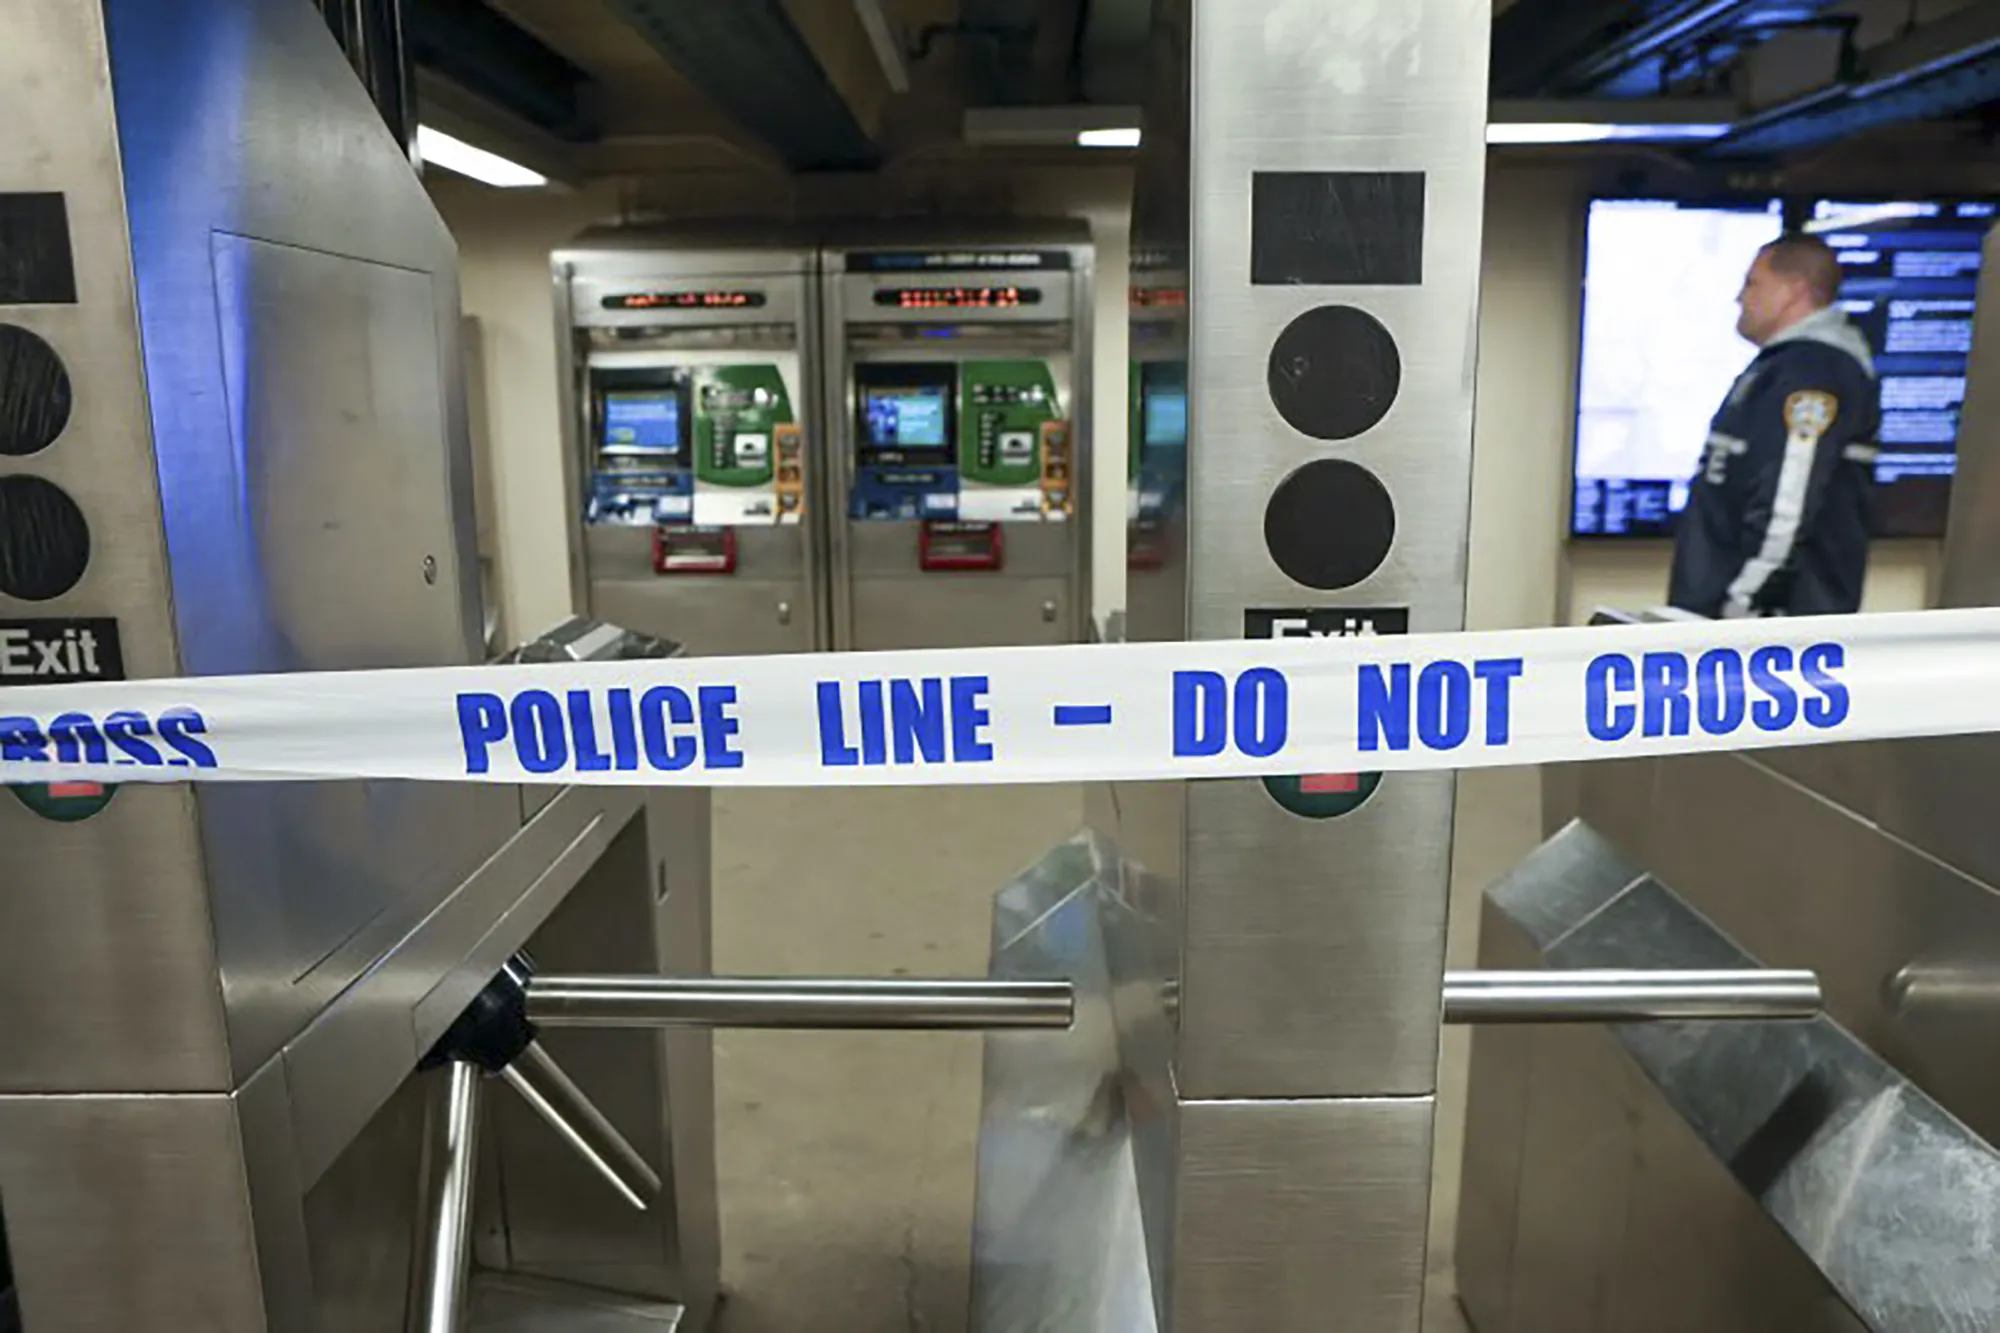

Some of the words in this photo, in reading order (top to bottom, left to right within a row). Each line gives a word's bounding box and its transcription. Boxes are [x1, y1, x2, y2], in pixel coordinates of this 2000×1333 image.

[0, 629, 99, 675] Exit
[457, 685, 743, 774] POLICE
[818, 675, 993, 767] LINE
[1173, 666, 1289, 758] DO
[1357, 657, 1524, 752] NOT
[1586, 641, 1849, 742] CROSS
